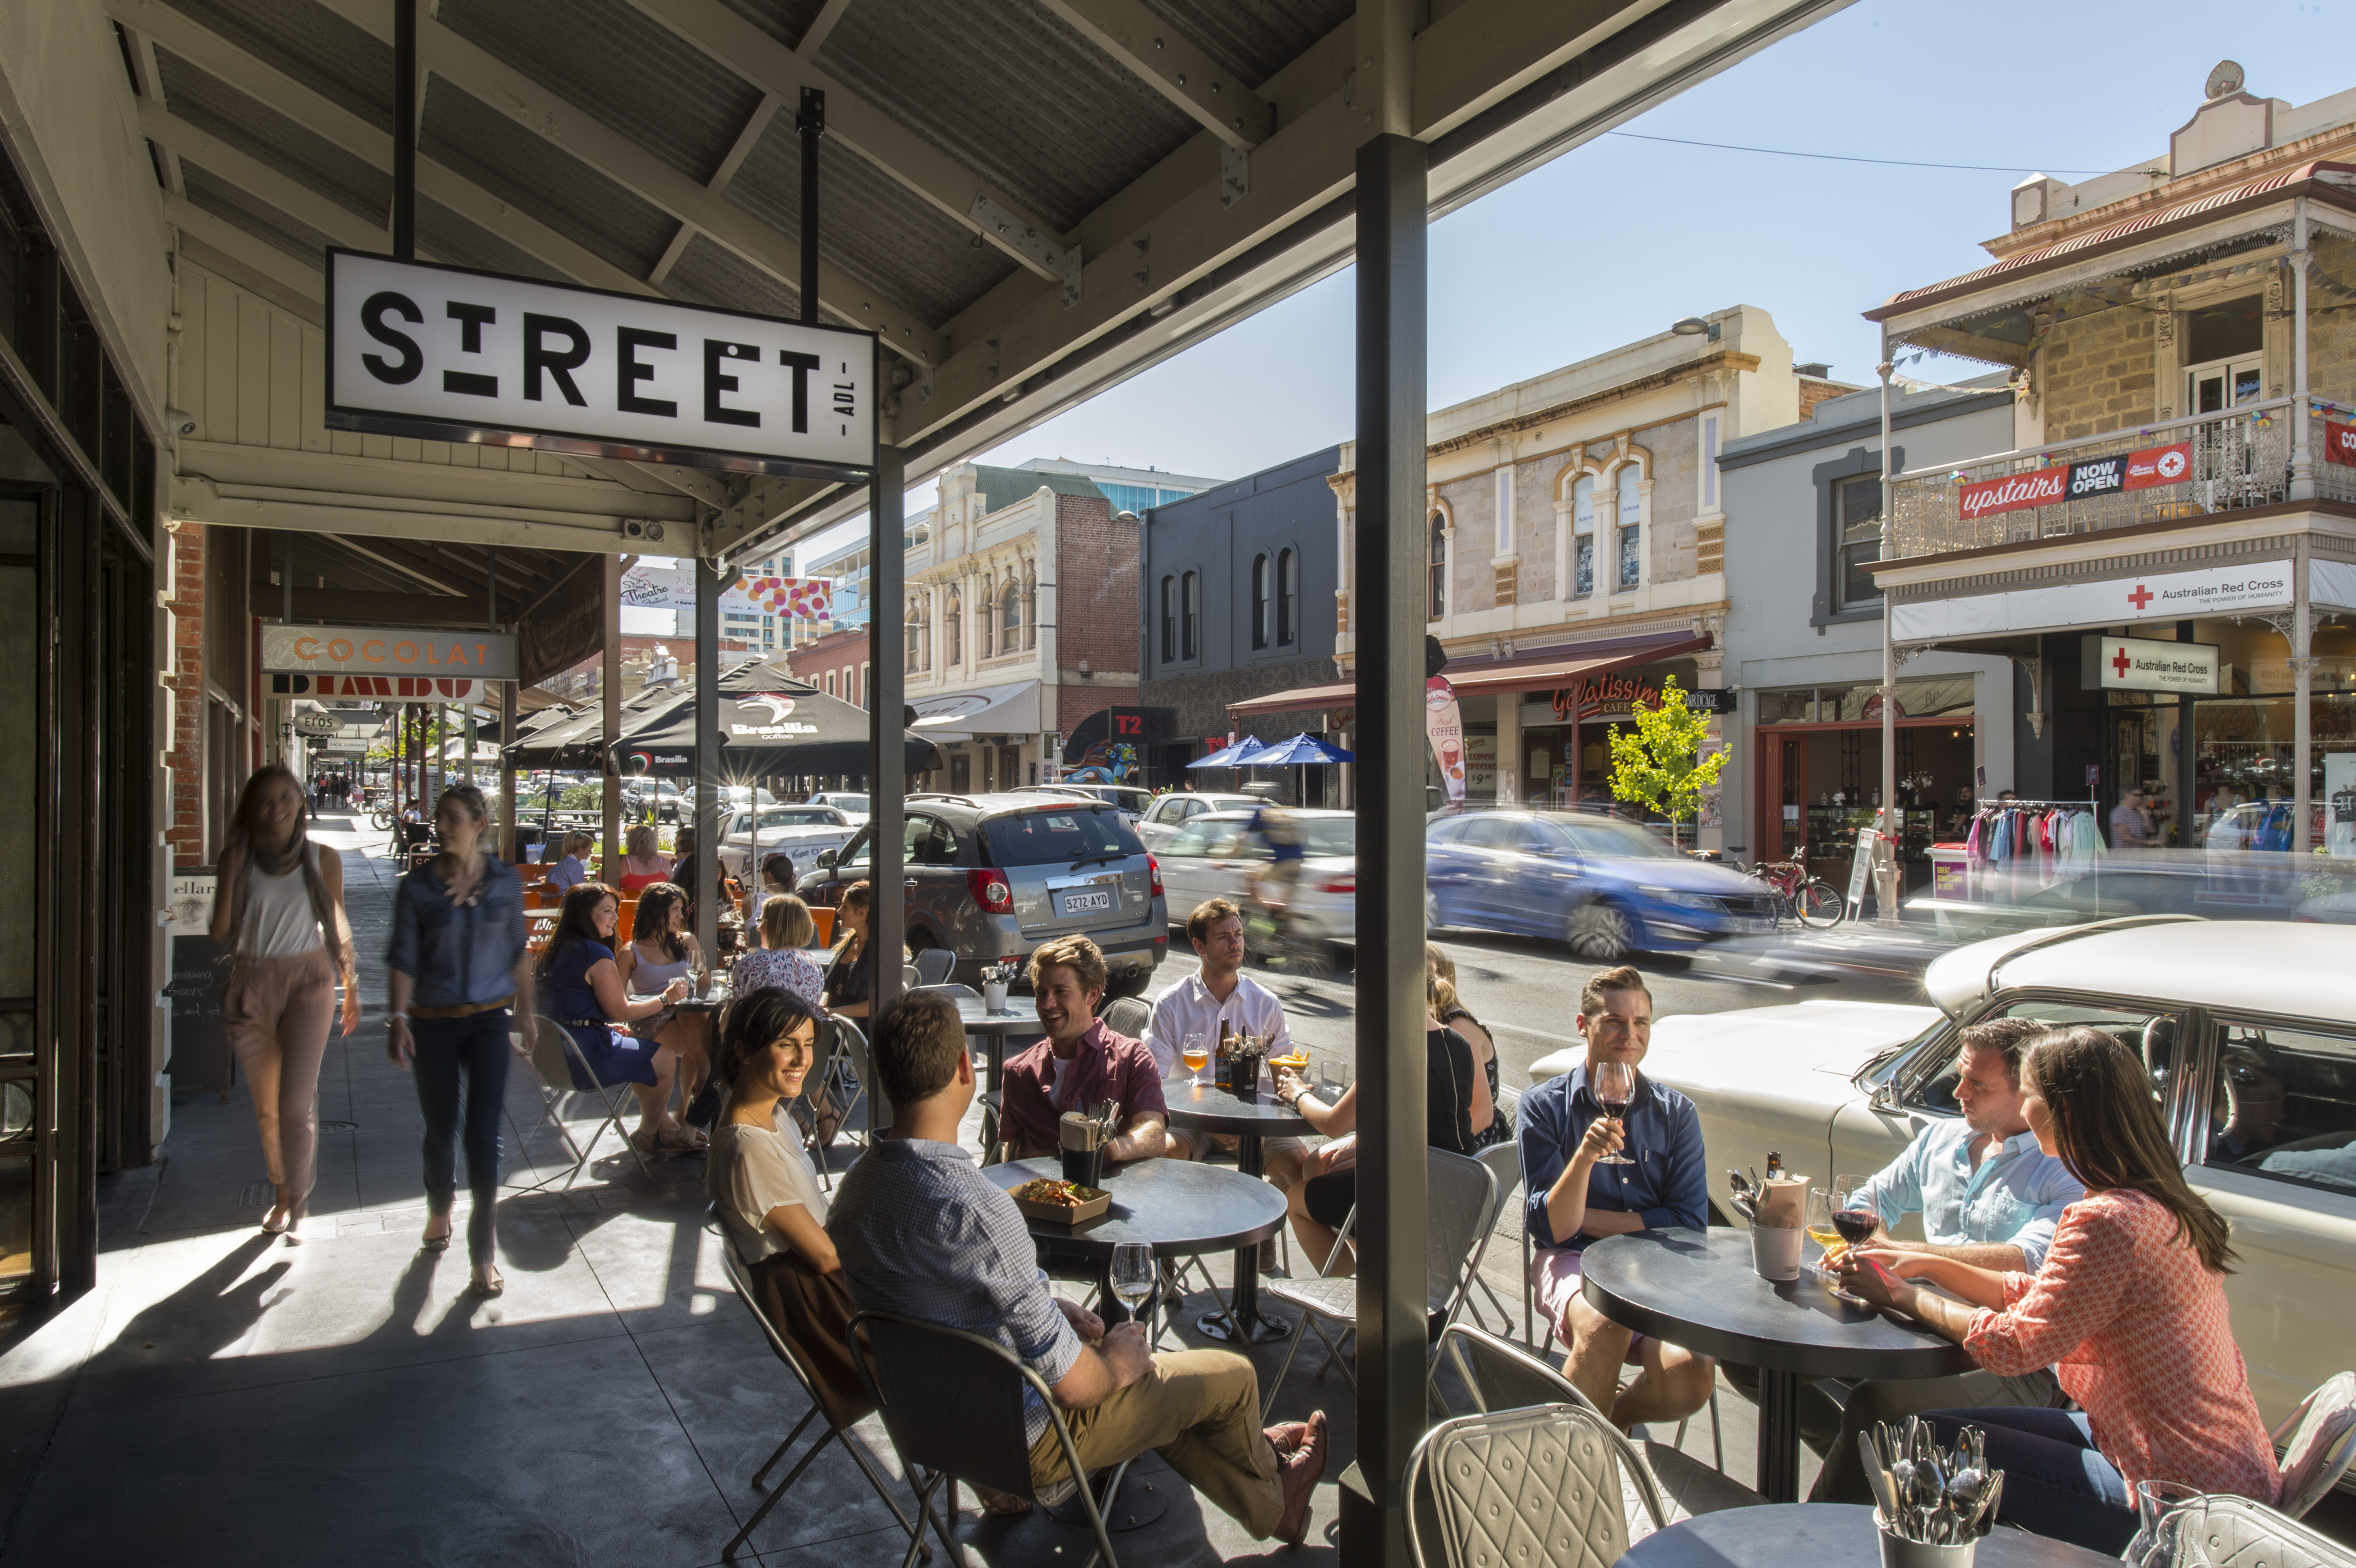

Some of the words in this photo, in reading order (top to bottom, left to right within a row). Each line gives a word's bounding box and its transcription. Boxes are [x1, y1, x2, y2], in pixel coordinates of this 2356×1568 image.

[361, 290, 820, 434] STREET
[2075, 461, 2116, 480] NOW
[2130, 467, 2150, 475] power
[2160, 467, 2168, 476] RED
[2072, 474, 2119, 494] OPEN
[1963, 475, 2063, 517] upstairs
[624, 572, 644, 584] Fringe
[676, 577, 681, 585] 7
[687, 577, 693, 586] 10
[623, 580, 648, 589] Street
[2161, 586, 2217, 599] Australian
[2222, 582, 2244, 593] Red
[2248, 580, 2283, 590] Cross
[620, 584, 669, 602] Theatre
[2248, 590, 2283, 599] HUMANITY
[642, 594, 669, 605] Festival
[294, 637, 489, 666] COCOLAT
[2136, 659, 2171, 672] Australian
[2173, 662, 2186, 673] Red
[2188, 663, 2208, 674] Cross
[1686, 694, 1717, 707] BIRDCAGE
[1603, 703, 1630, 713] CAFE
[1781, 701, 1793, 715] BC
[1115, 715, 1142, 734] T2
[1434, 714, 1455, 726] Fresh
[731, 722, 818, 734] Brasilia
[655, 755, 687, 763] Brasilia
[1937, 866, 1951, 874] GREAT
[1943, 882, 1954, 891] HERE
